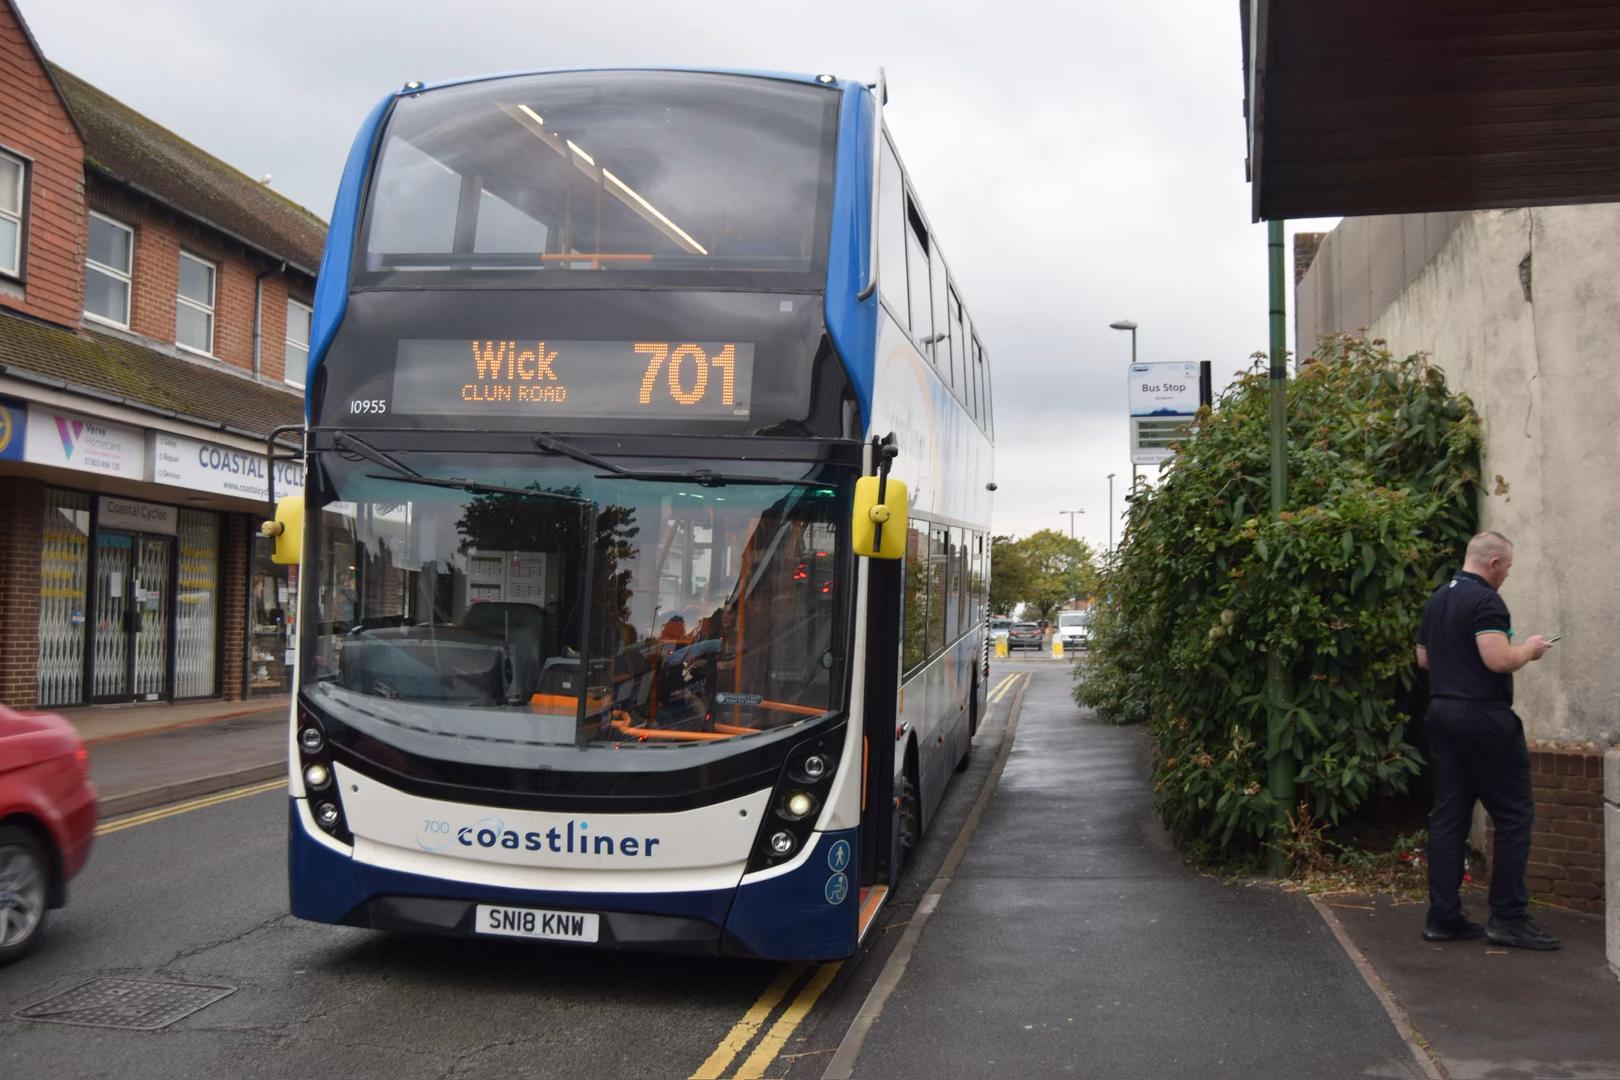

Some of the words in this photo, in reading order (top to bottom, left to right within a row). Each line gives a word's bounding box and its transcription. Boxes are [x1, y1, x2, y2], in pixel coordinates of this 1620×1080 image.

[472, 341, 559, 381] Wick
[634, 343, 735, 405] 701
[461, 384, 512, 401] CLUN
[518, 385, 569, 402] ROAD
[1142, 384, 1160, 392] Bus
[1163, 383, 1186, 393] Stop
[350, 399, 386, 414] 10955
[199, 445, 264, 479] COASTAL
[107, 500, 140, 517] Coastal
[141, 506, 167, 521] Cycles
[423, 819, 450, 834] 700
[456, 819, 660, 857] coastliner
[489, 909, 536, 933] SN18
[542, 913, 585, 937] KNW
